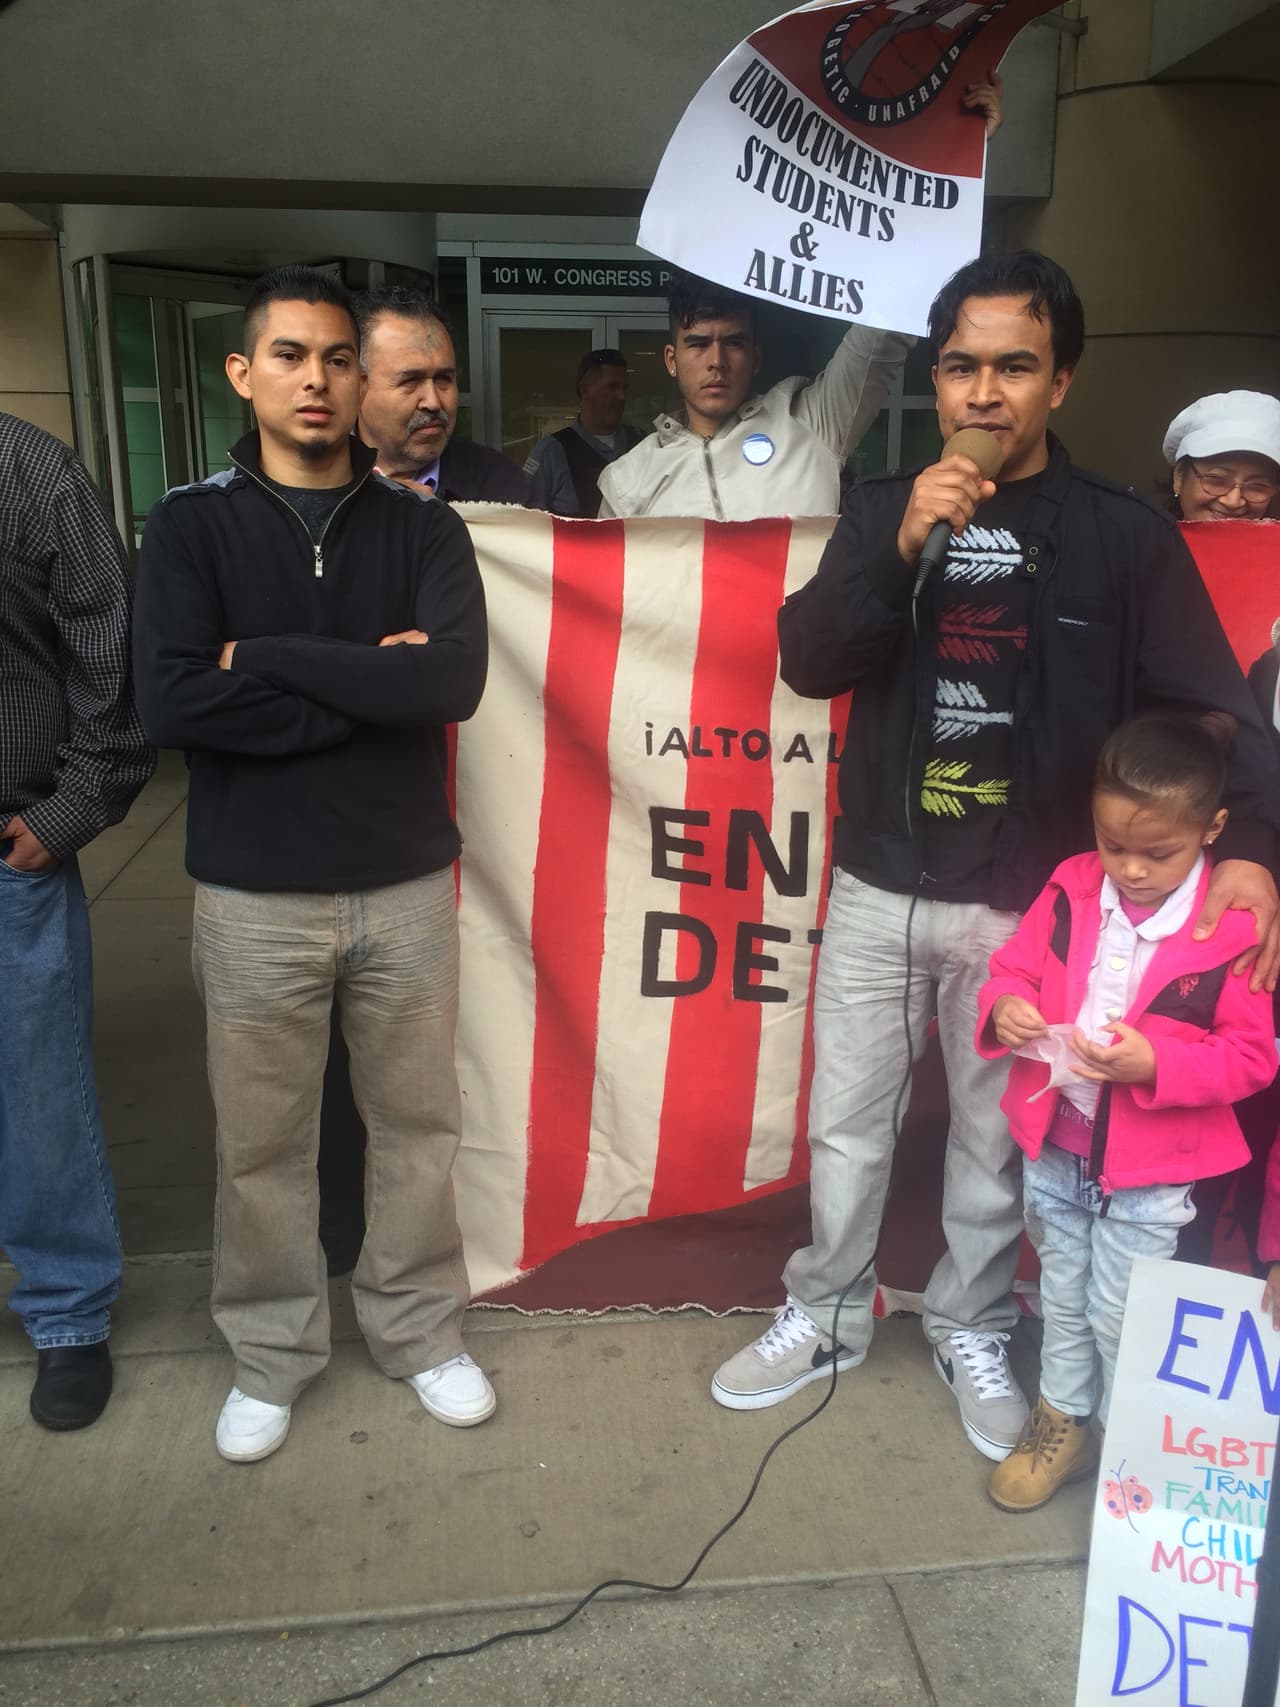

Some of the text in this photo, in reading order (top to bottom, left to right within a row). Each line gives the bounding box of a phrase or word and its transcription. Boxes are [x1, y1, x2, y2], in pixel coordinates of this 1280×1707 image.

[868, 45, 960, 121] UNAFRAID
[728, 58, 960, 210] UNDOCUMENTED
[736, 135, 896, 242] STUDENTS
[789, 221, 819, 261] &
[492, 267, 519, 284] 101
[526, 268, 547, 284] W.
[554, 268, 652, 287] CONGRESS
[743, 249, 865, 315] ALLIES
[783, 733, 814, 763] A
[648, 806, 809, 897] EN
[1156, 1297, 1280, 1415] EN
[1162, 1415, 1277, 1477] LGBT
[1194, 1466, 1271, 1502] TRAN
[1151, 1540, 1259, 1601] MOTH
[1182, 1516, 1260, 1567] CHIL
